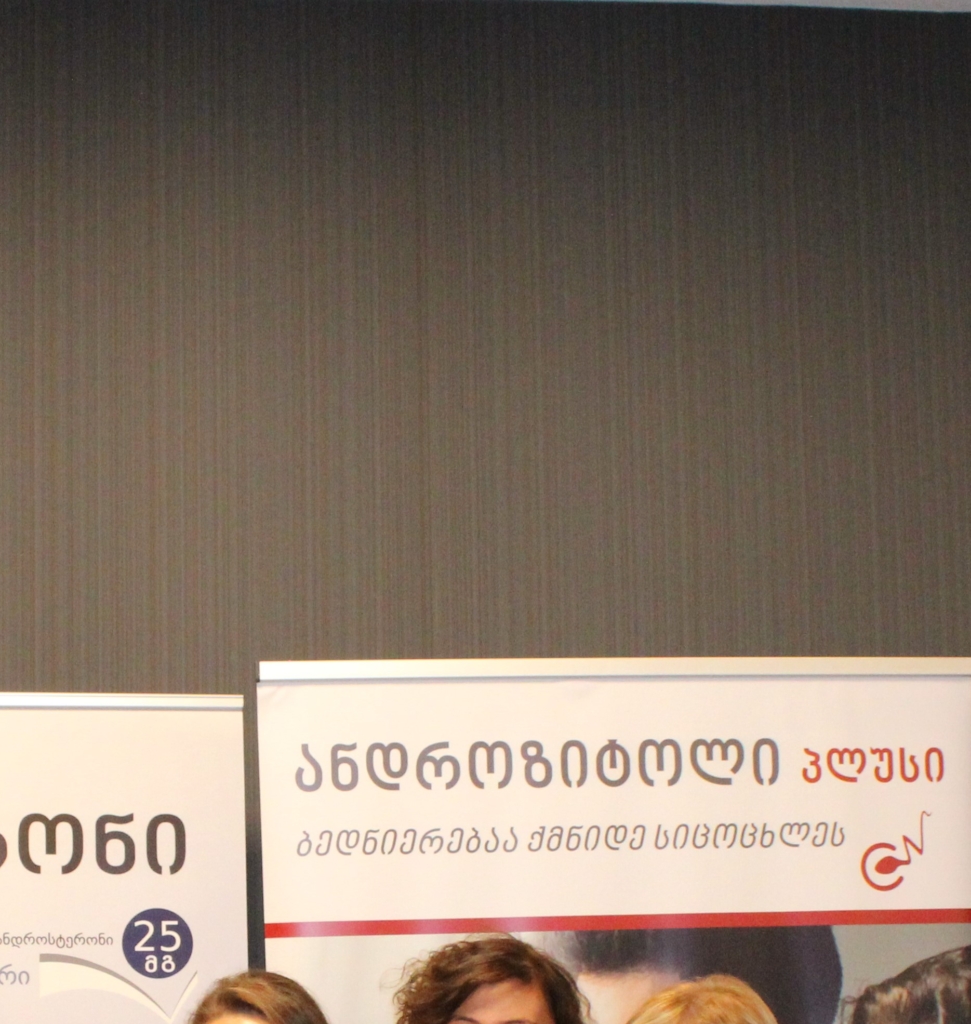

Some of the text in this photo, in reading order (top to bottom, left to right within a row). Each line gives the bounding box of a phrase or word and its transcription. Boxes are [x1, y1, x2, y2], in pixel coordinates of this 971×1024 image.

[295, 738, 944, 793] ანდროზიტოლი პლუსი
[296, 826, 518, 857] ბედნიერებაა
[654, 821, 846, 851] სიცოცხლეს
[133, 920, 182, 952] 25
[144, 954, 176, 973] მგ
